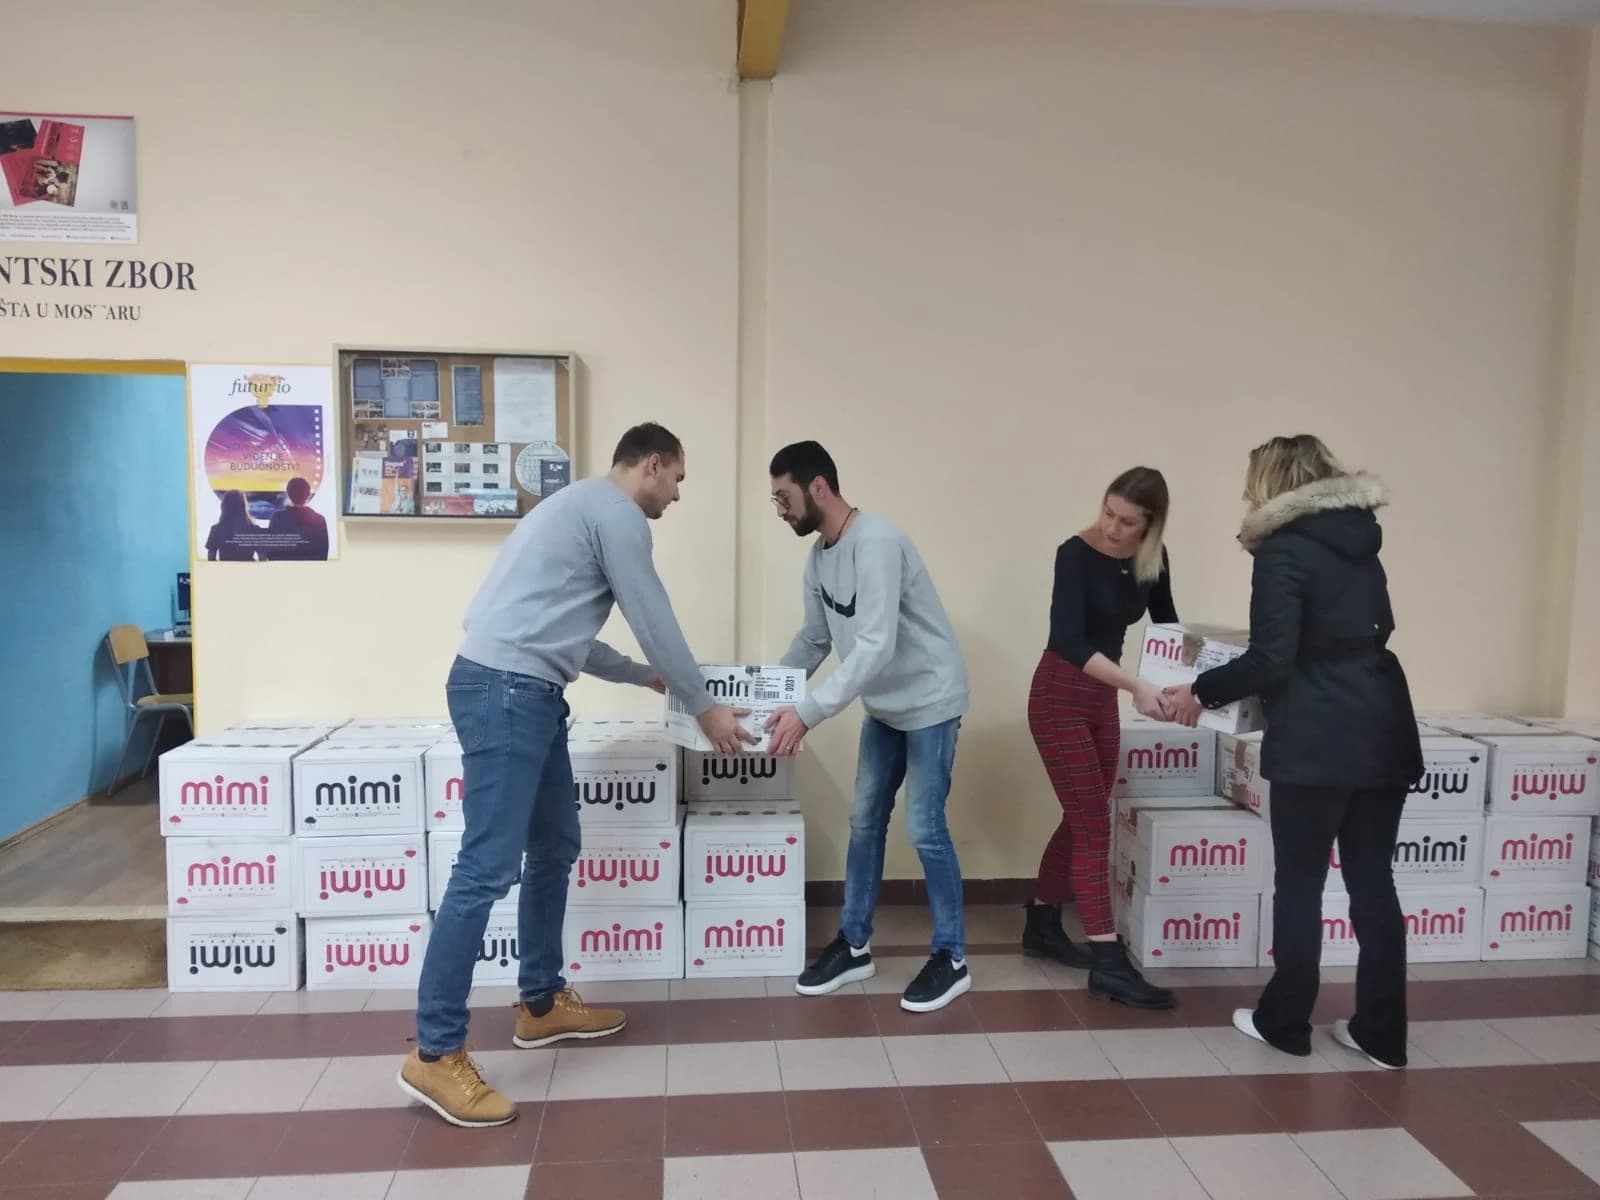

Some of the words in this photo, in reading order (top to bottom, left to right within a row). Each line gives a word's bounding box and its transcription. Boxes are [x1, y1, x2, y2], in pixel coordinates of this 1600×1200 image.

[104, 259, 197, 290] ZBOR
[37, 303, 48, 318] U
[1126, 742, 1199, 769] mimi
[702, 756, 776, 785] mimi
[181, 775, 269, 805] mimi
[316, 774, 401, 806] mimi
[1511, 774, 1586, 801] mimi
[1170, 838, 1247, 866] mimi
[1394, 835, 1468, 863] mimi
[1501, 833, 1574, 860] mimi
[188, 855, 276, 886] mimi
[320, 868, 405, 900] mimi
[577, 859, 660, 888] mimi
[705, 855, 786, 884] mimi
[1163, 912, 1240, 940] mimi
[1501, 904, 1573, 932] mimi
[581, 923, 663, 952] mimi
[705, 918, 785, 948] mimi
[190, 945, 275, 975] mimi
[325, 944, 409, 973] mimi
